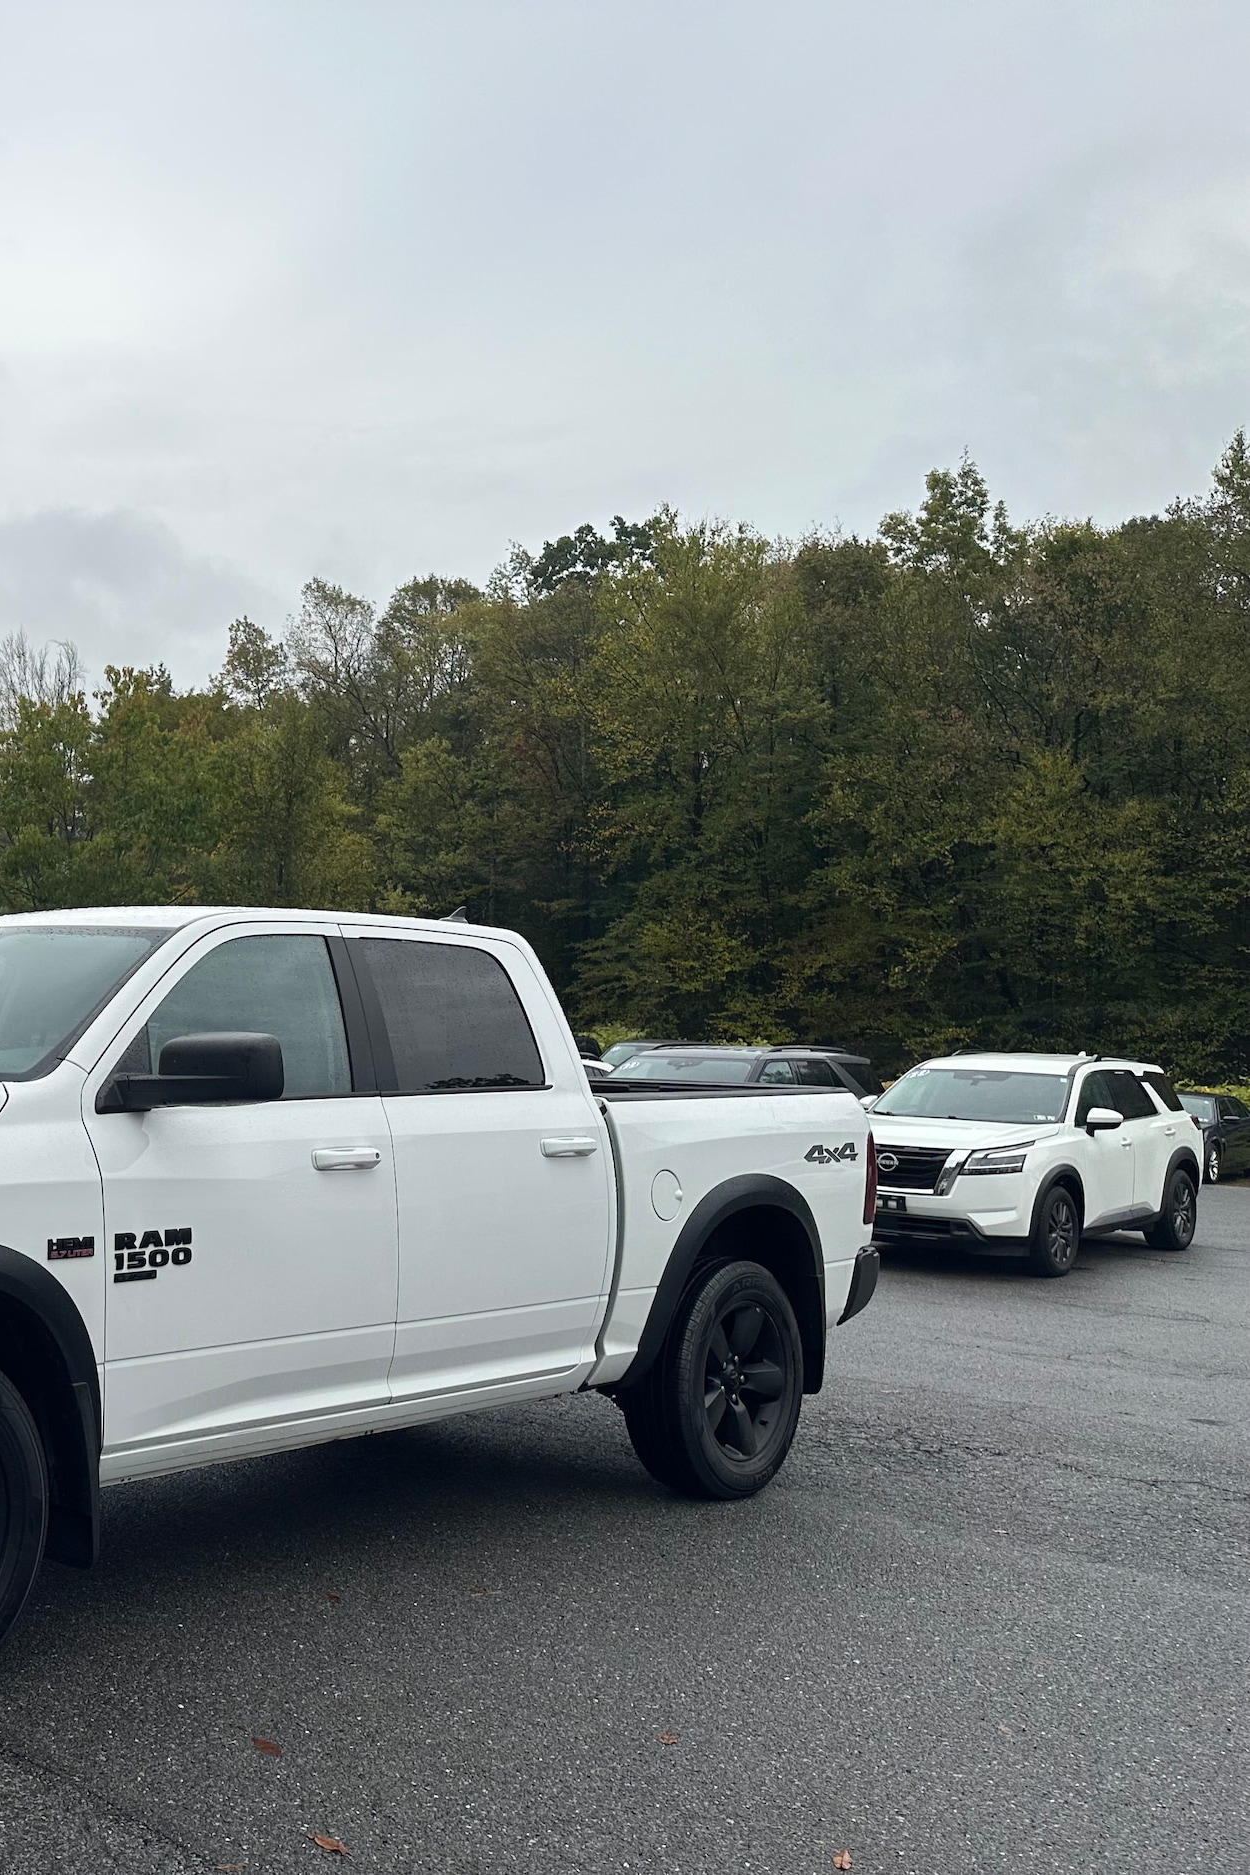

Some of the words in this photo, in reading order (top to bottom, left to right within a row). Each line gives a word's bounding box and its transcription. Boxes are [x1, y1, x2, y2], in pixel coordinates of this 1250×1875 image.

[48, 1236, 95, 1250] HEMI
[114, 1227, 192, 1250] RAM
[114, 1247, 192, 1270] 1500
